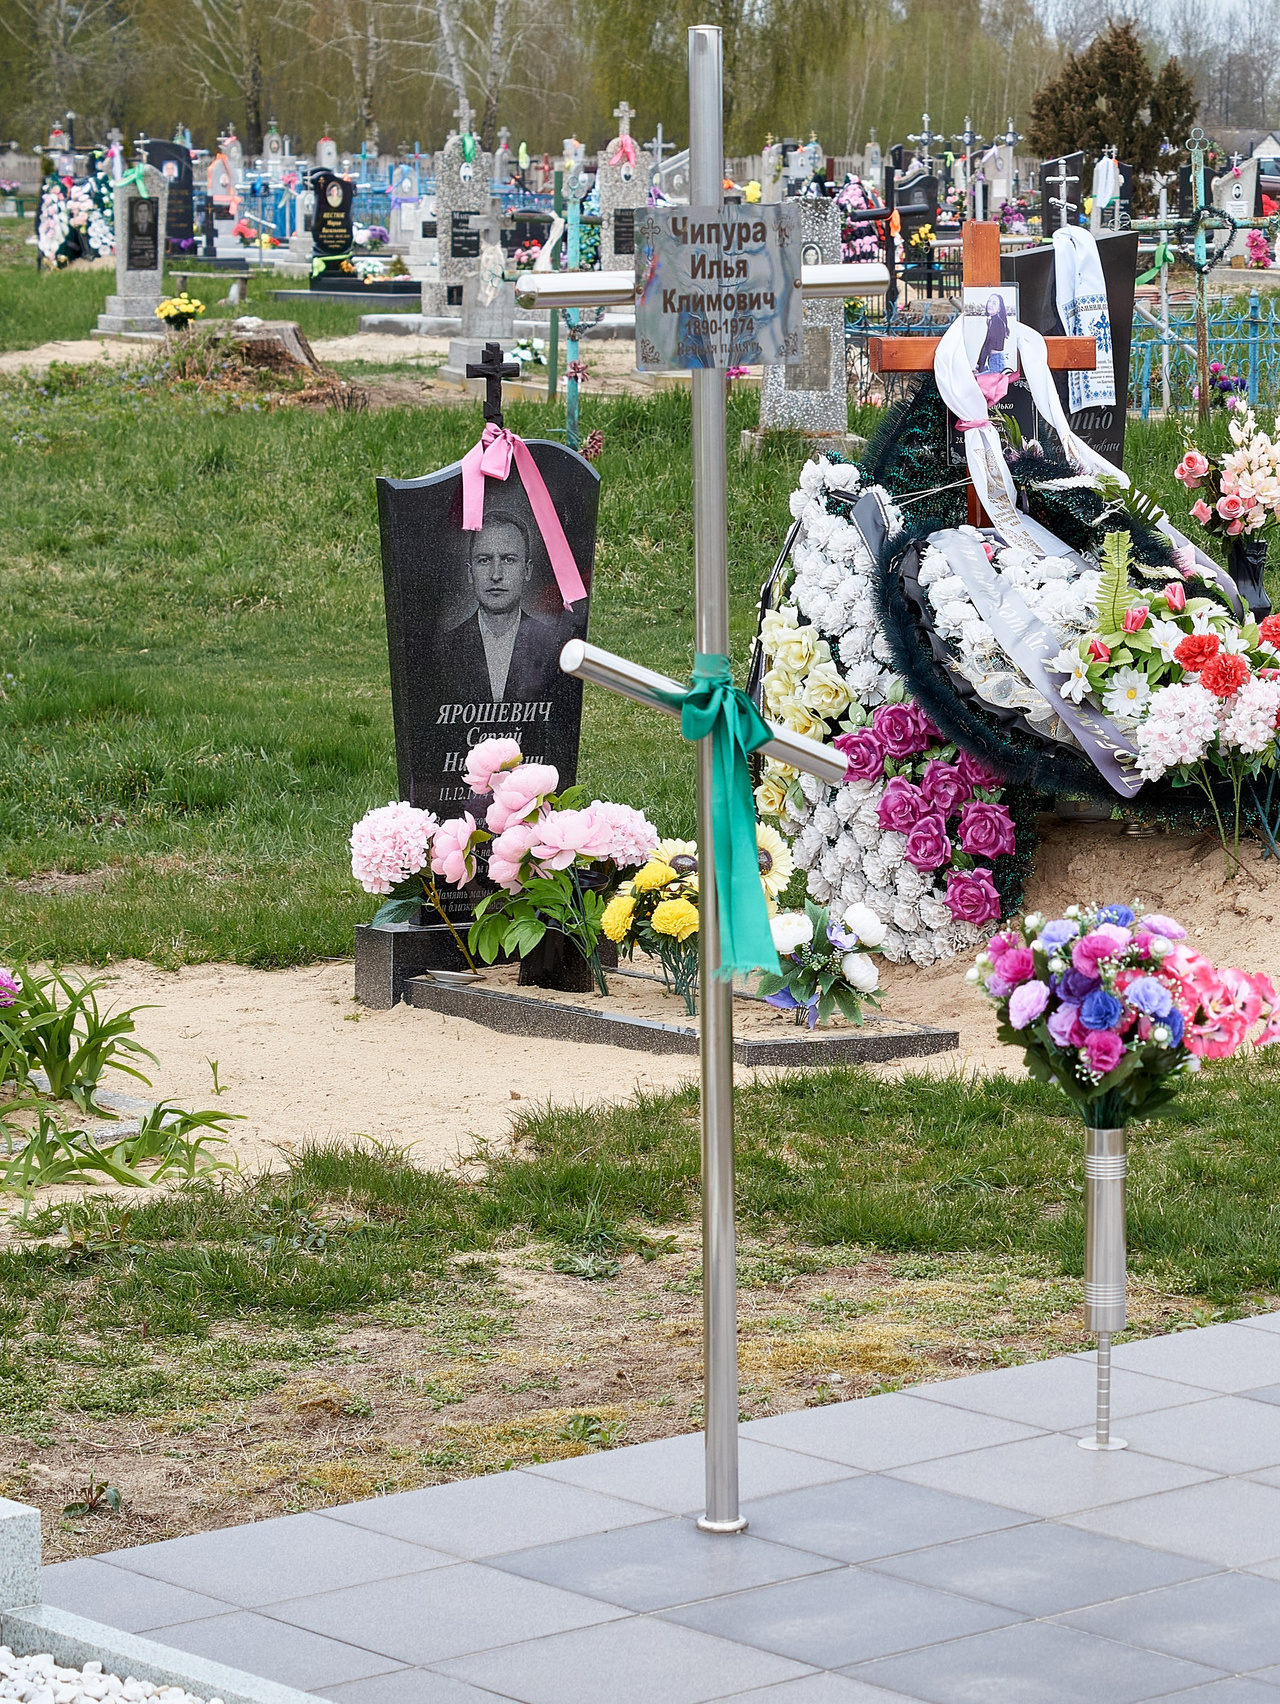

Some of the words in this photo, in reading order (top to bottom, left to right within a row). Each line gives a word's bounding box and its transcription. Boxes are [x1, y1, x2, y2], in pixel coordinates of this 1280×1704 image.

[672, 217, 766, 250] Чипура
[690, 254, 748, 280] Илья
[662, 288, 775, 314] Климович
[685, 317, 755, 336] 1890-1974
[436, 702, 553, 724] ЯРОШЕВИЧ
[1053, 682, 1145, 790] Любимо
